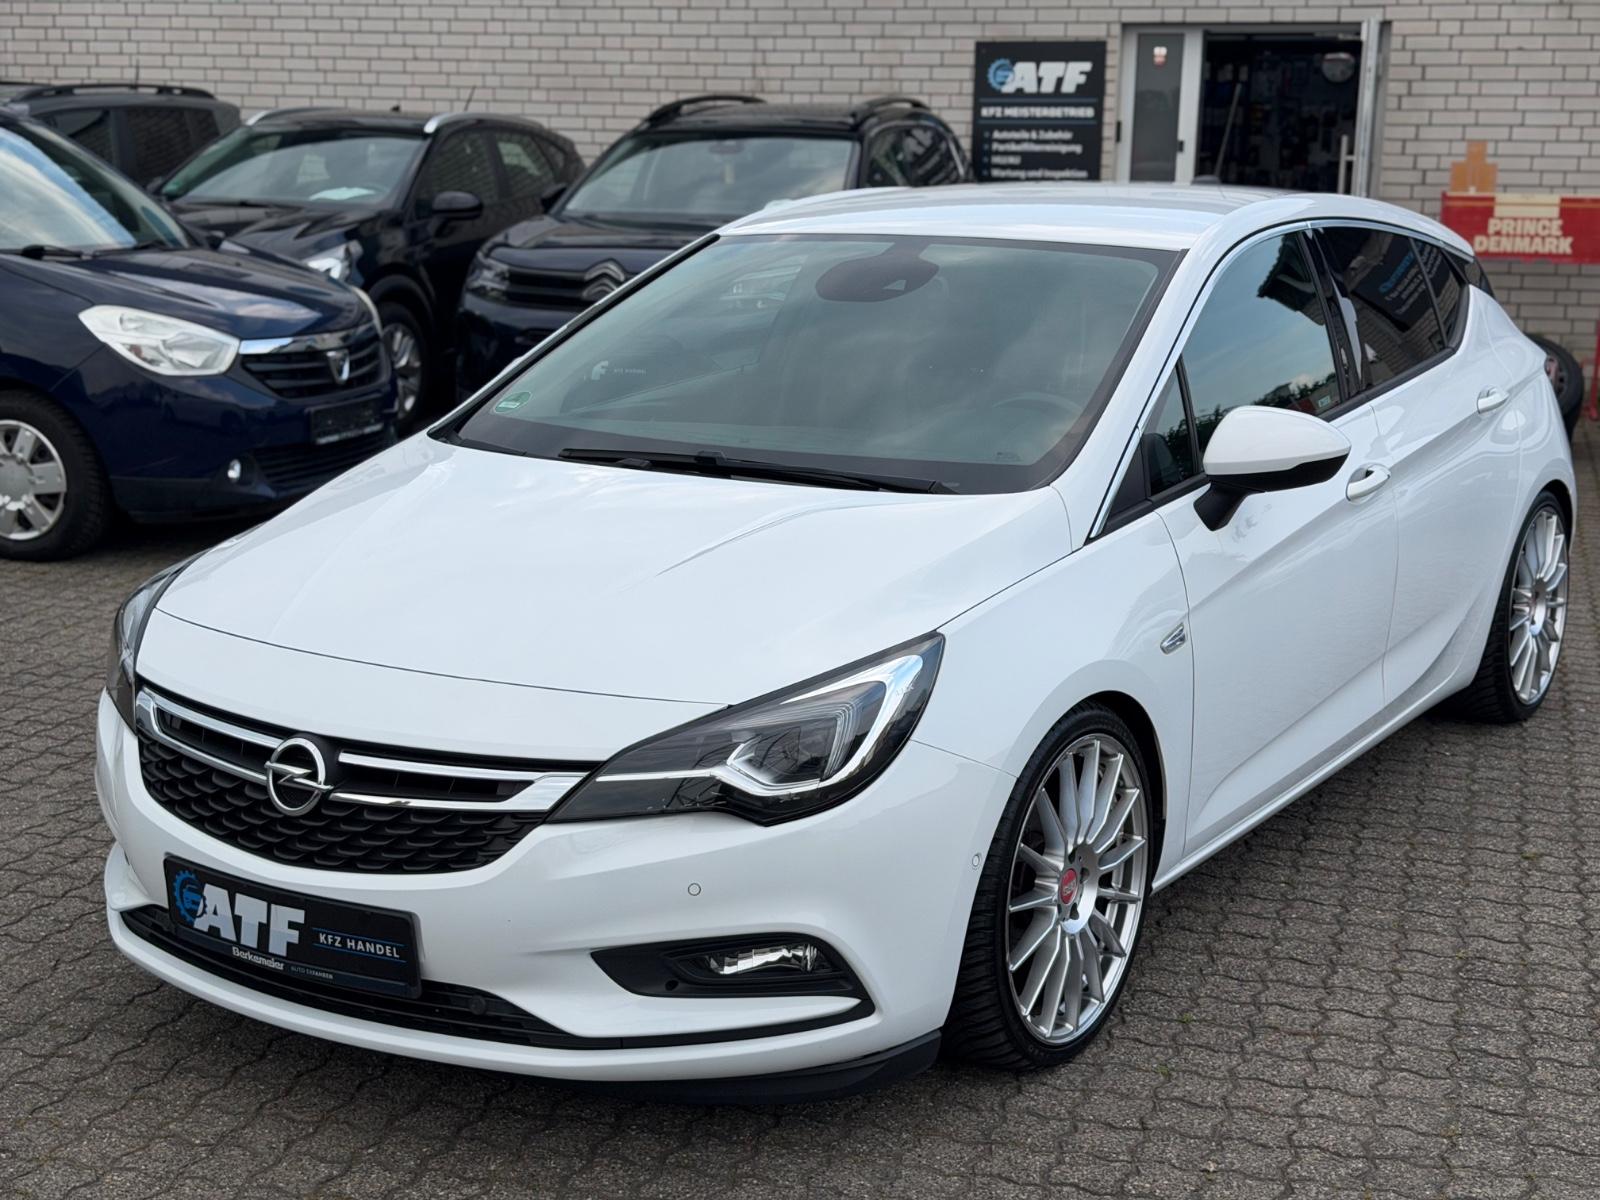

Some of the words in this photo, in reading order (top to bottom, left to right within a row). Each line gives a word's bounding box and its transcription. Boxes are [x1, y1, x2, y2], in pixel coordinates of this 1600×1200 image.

[1001, 61, 1093, 94] ATF
[1487, 218, 1563, 236] PRINCE
[1474, 235, 1573, 254] DENMARK
[194, 883, 305, 957] ATF
[319, 932, 342, 948] KFZ
[346, 939, 400, 959] HANDEL
